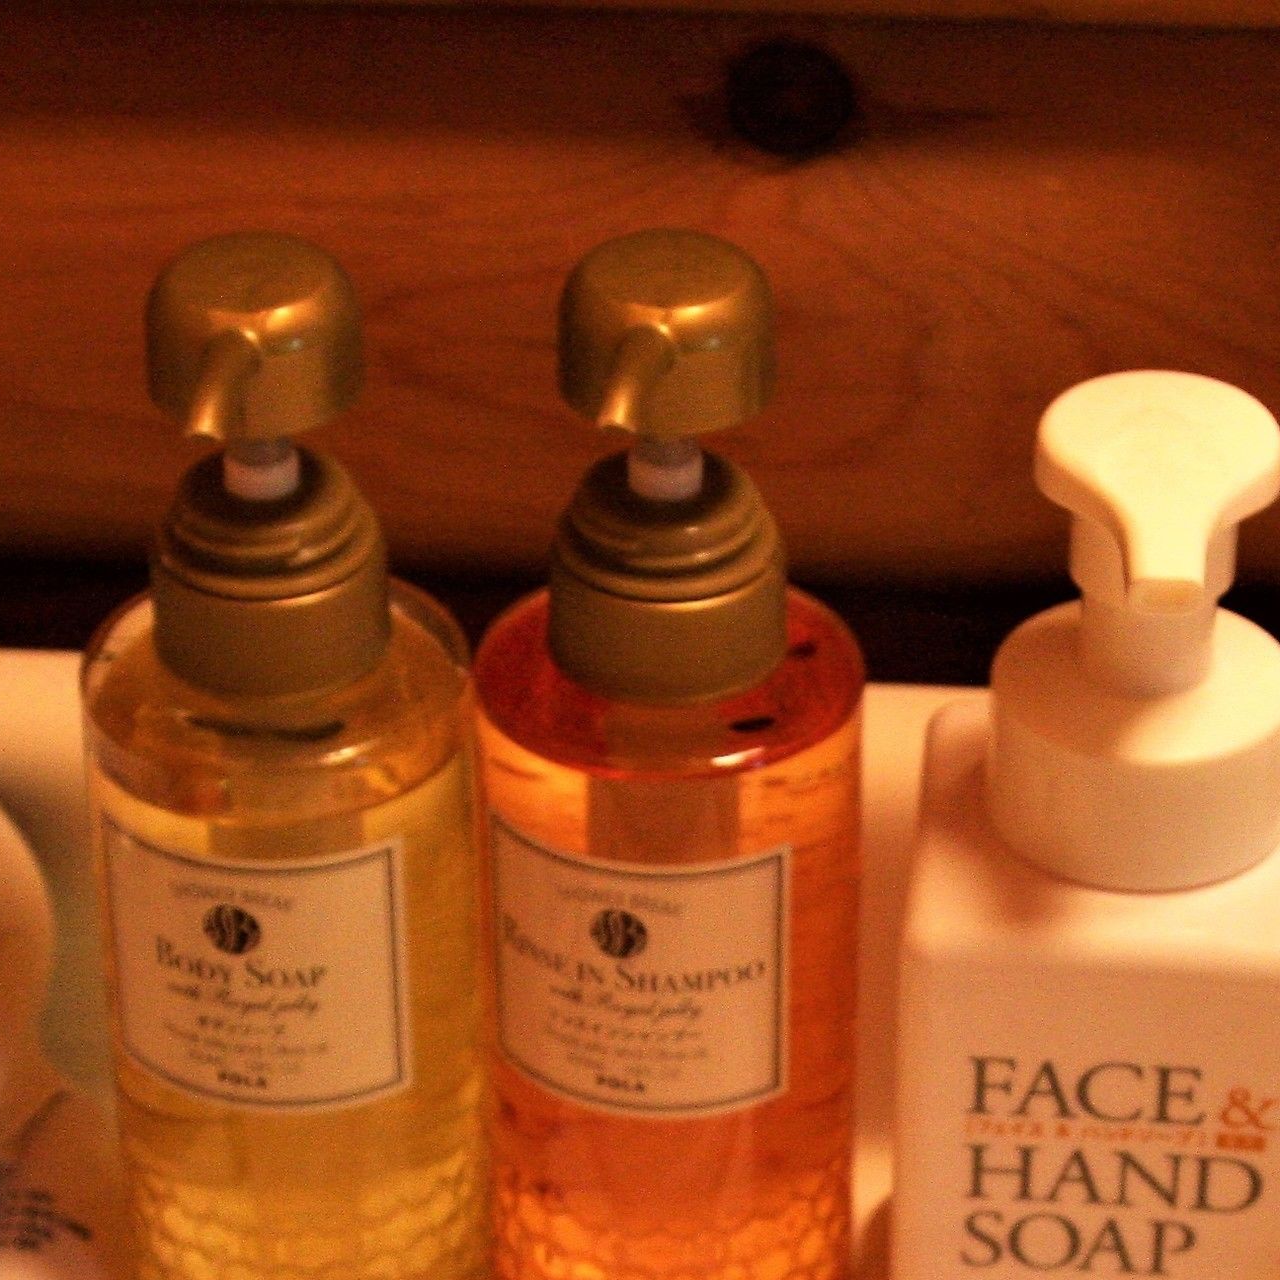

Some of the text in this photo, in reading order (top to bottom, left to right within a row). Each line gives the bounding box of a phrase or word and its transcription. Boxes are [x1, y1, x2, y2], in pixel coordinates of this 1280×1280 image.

[968, 1055, 1277, 1131] FACE &
[964, 1143, 1263, 1215] HAND
[959, 1208, 1197, 1276] SOAP
